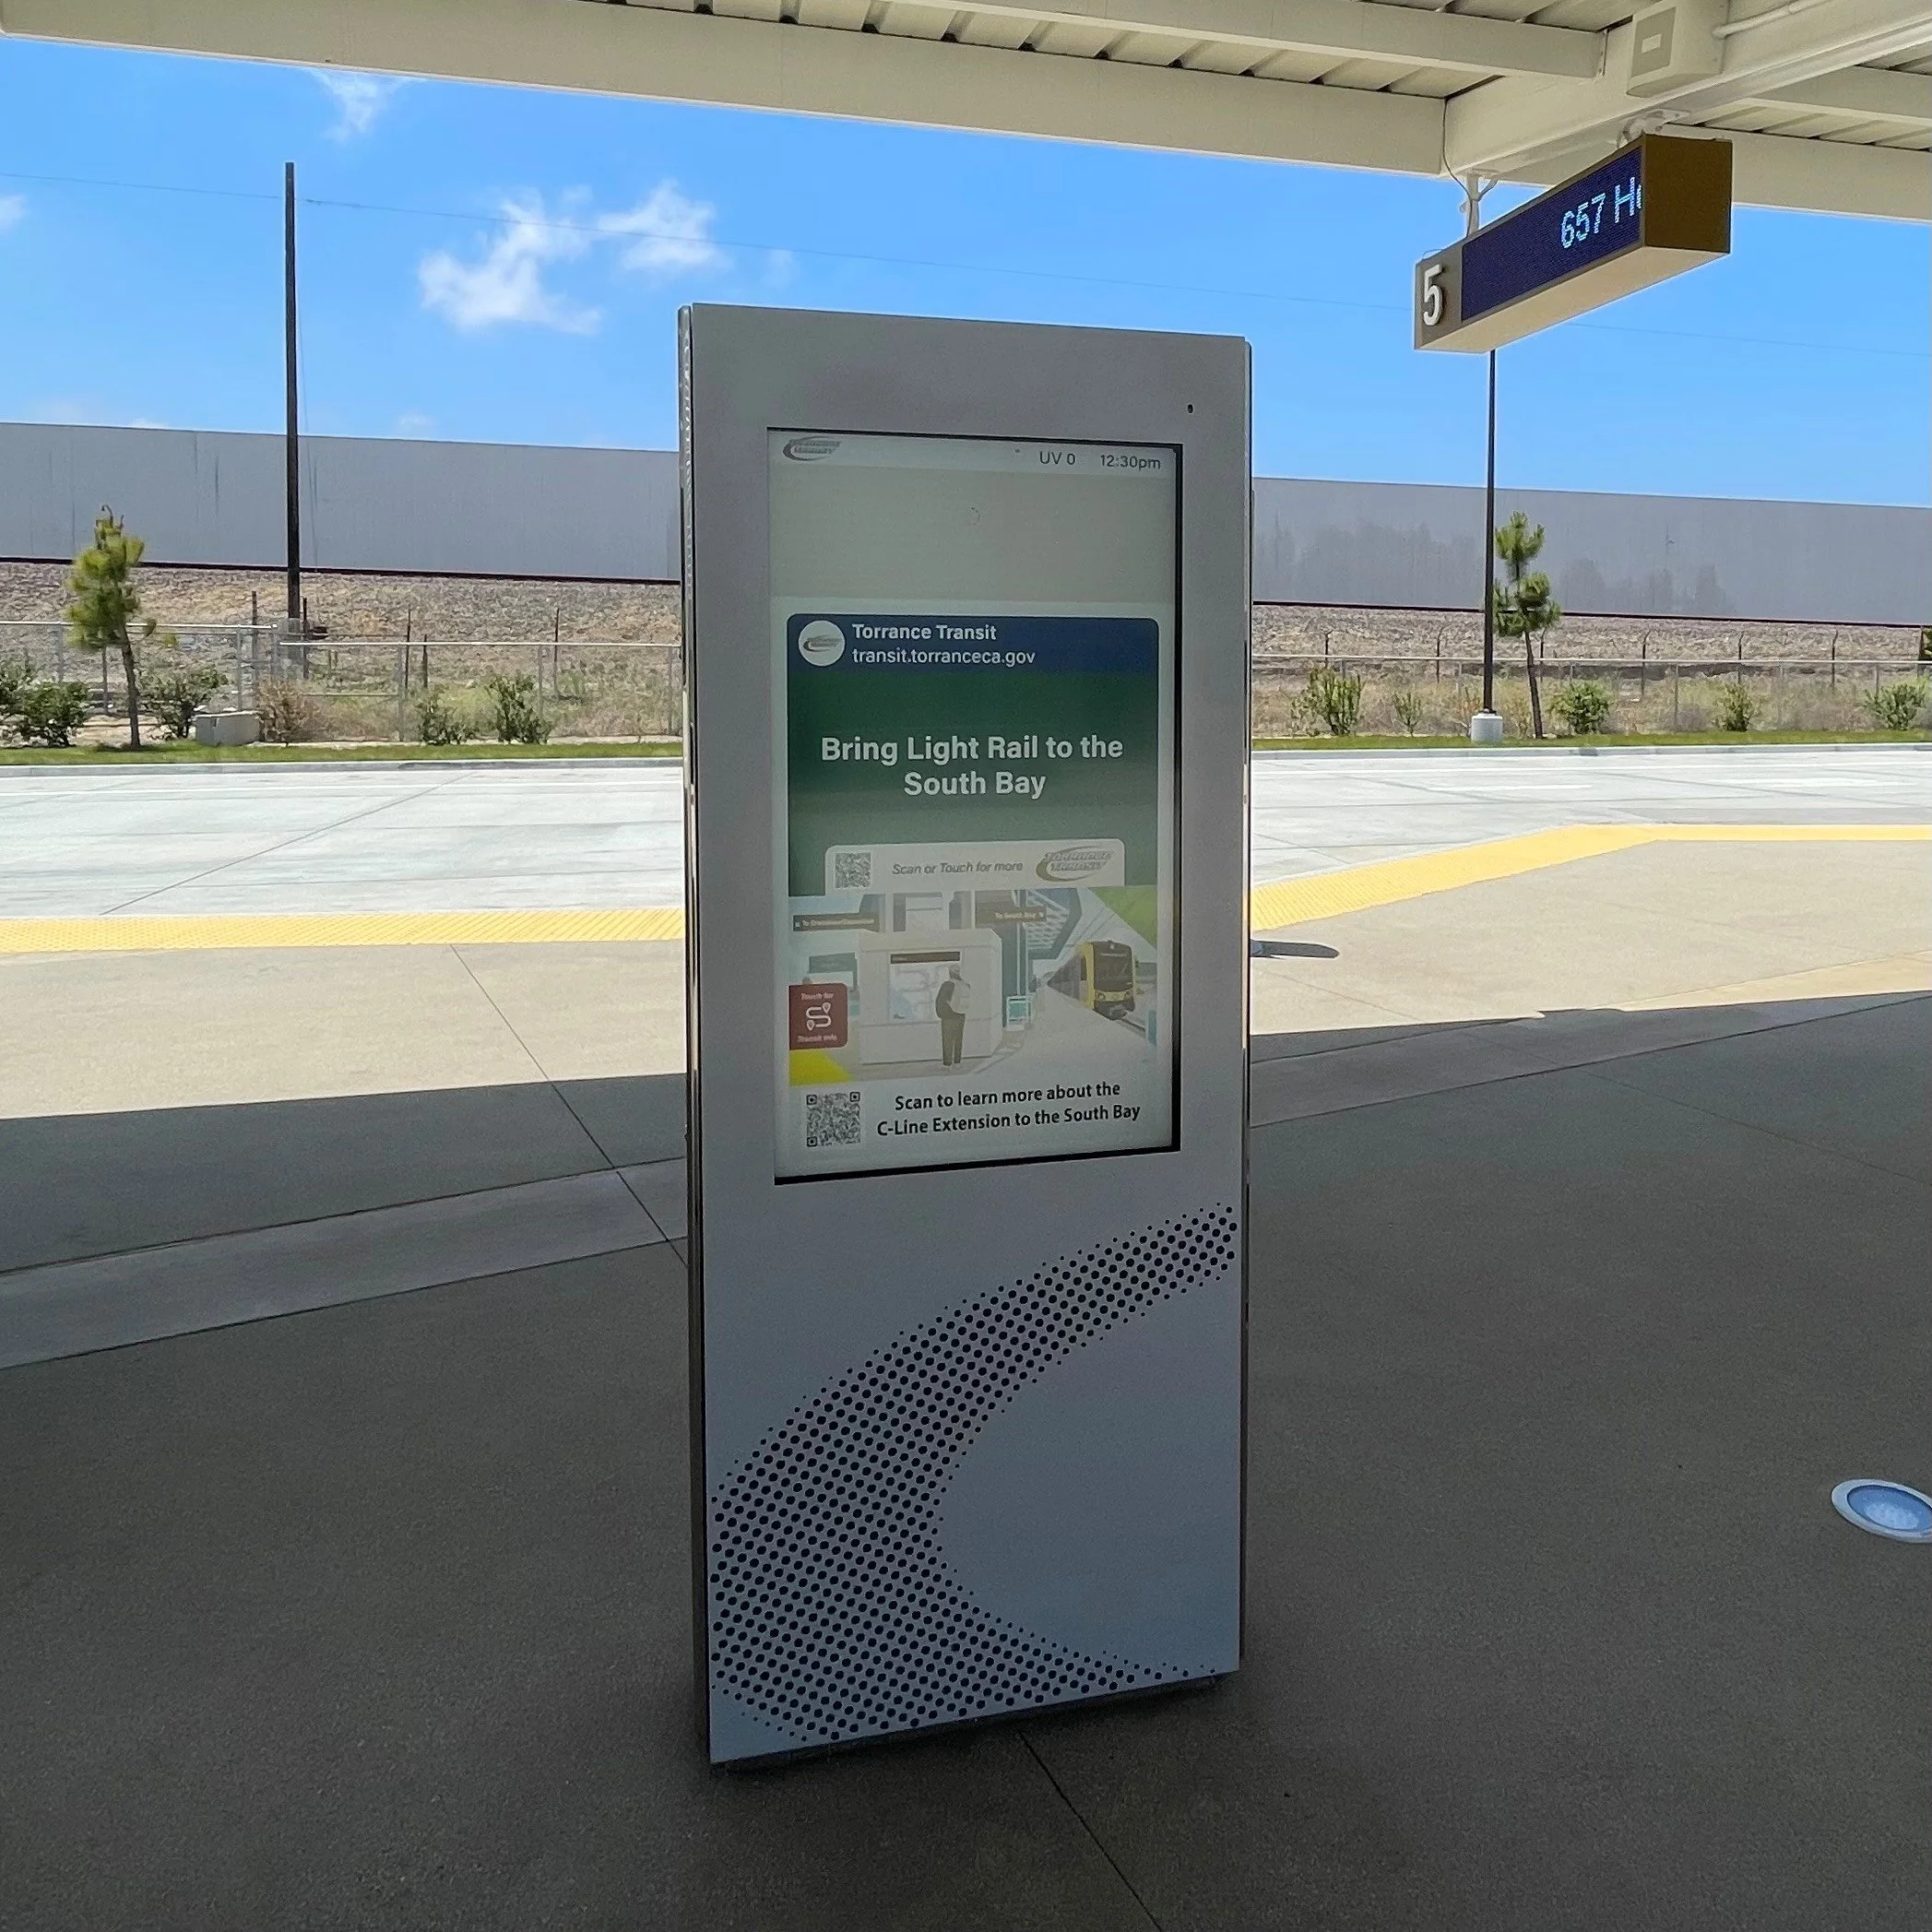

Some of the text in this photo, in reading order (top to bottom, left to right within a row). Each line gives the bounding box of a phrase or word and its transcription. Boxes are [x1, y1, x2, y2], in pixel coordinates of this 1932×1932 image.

[1560, 192, 1606, 249] 657
[1422, 264, 1443, 326] 5
[1039, 450, 1061, 465] UV
[1100, 454, 1161, 471] 12:30pm
[851, 622, 997, 641] Torrance Transit
[851, 646, 1036, 668] transit.torranceca.gov
[821, 734, 1124, 766] Bring Light Rail to the
[904, 770, 1047, 800] South Bay
[892, 860, 1024, 875] Scan or Touch for more
[895, 1081, 1120, 1111] Scan to learn more about the
[877, 1104, 1141, 1136] C-Line Extension to the South Bay
